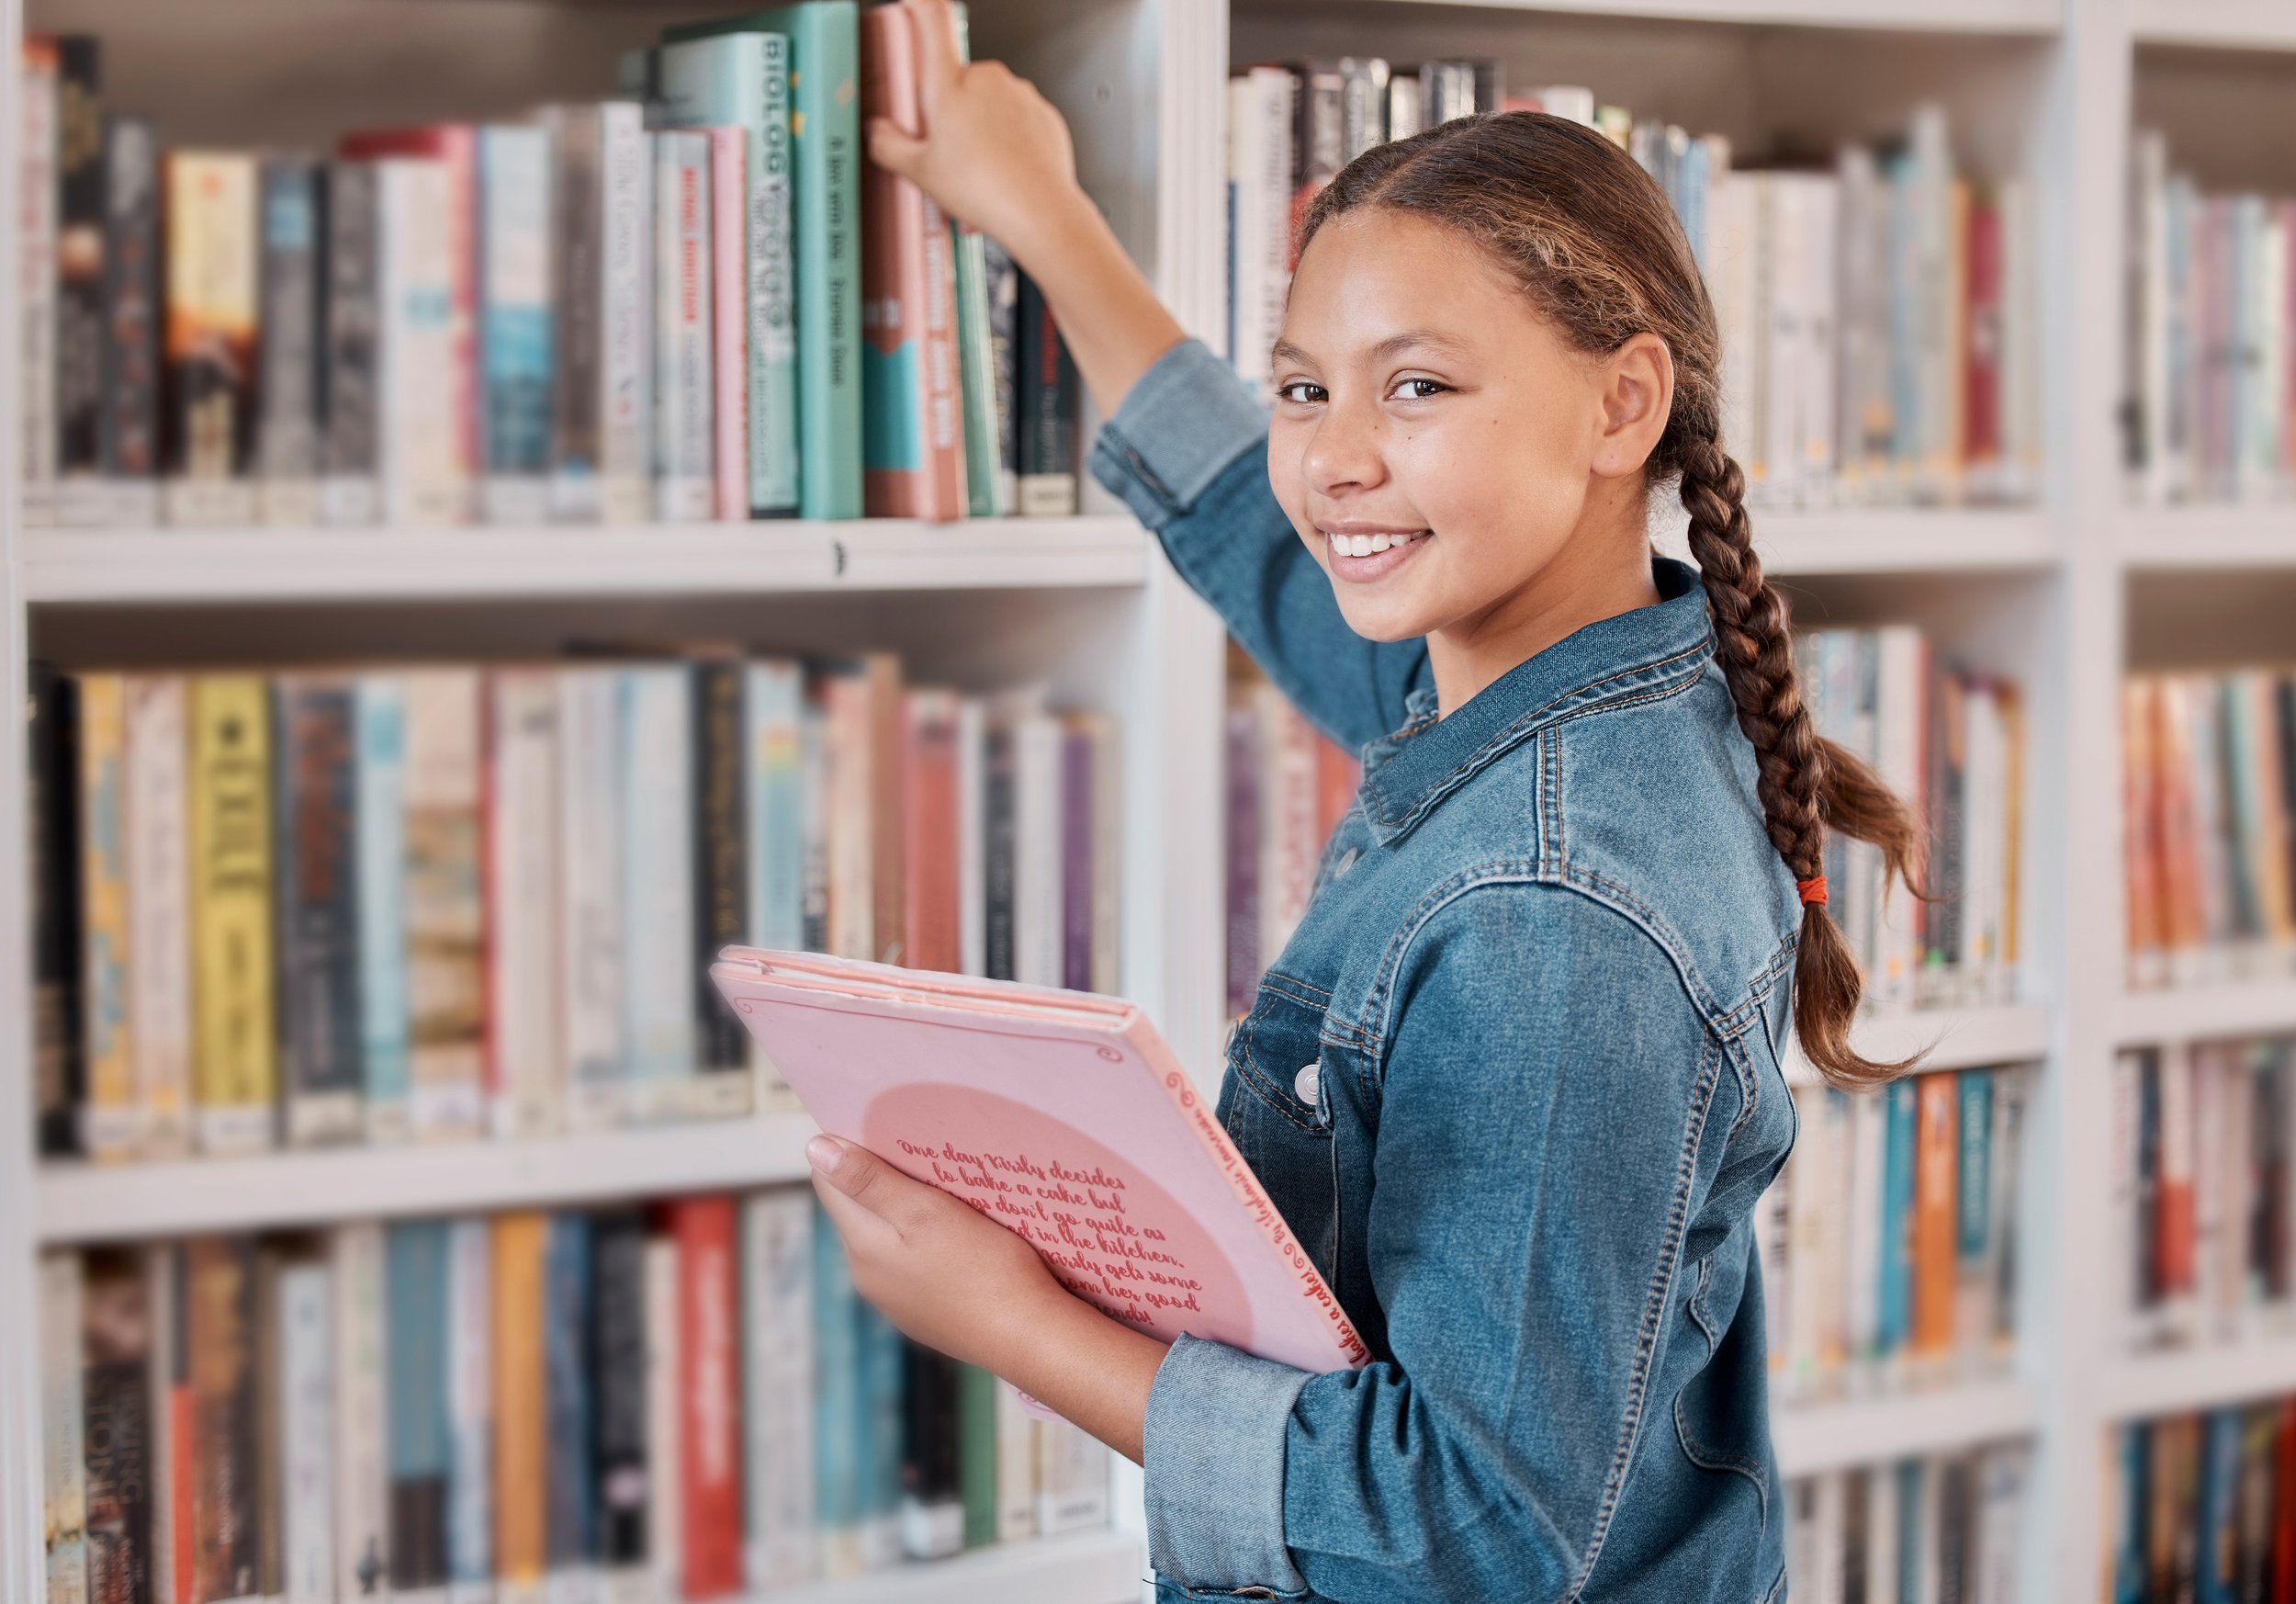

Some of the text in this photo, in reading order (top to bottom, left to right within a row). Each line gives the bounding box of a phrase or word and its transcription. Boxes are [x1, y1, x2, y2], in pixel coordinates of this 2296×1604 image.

[761, 40, 786, 194] BIOLOGY
[896, 1139, 939, 1158] One
[943, 1142, 985, 1171] day
[1050, 1160, 1125, 1190] decides
[932, 1162, 1125, 1214] to bake a cake but
[1234, 1171, 1275, 1227] Stephanie
[996, 1194, 1049, 1221] don't
[1052, 1211, 1081, 1227] go
[1086, 1215, 1139, 1237] quite
[1143, 1228, 1165, 1241] as
[1035, 1226, 1059, 1244] in
[1057, 1223, 1095, 1249] the
[1102, 1276, 1141, 1302] her
[1146, 1293, 1201, 1313] good
[1106, 1260, 1144, 1281] gets
[1149, 1271, 1202, 1291] some
[1300, 1267, 1331, 1306] cake!
[1330, 1307, 1340, 1320] a
[1337, 1320, 1366, 1364] bakes
